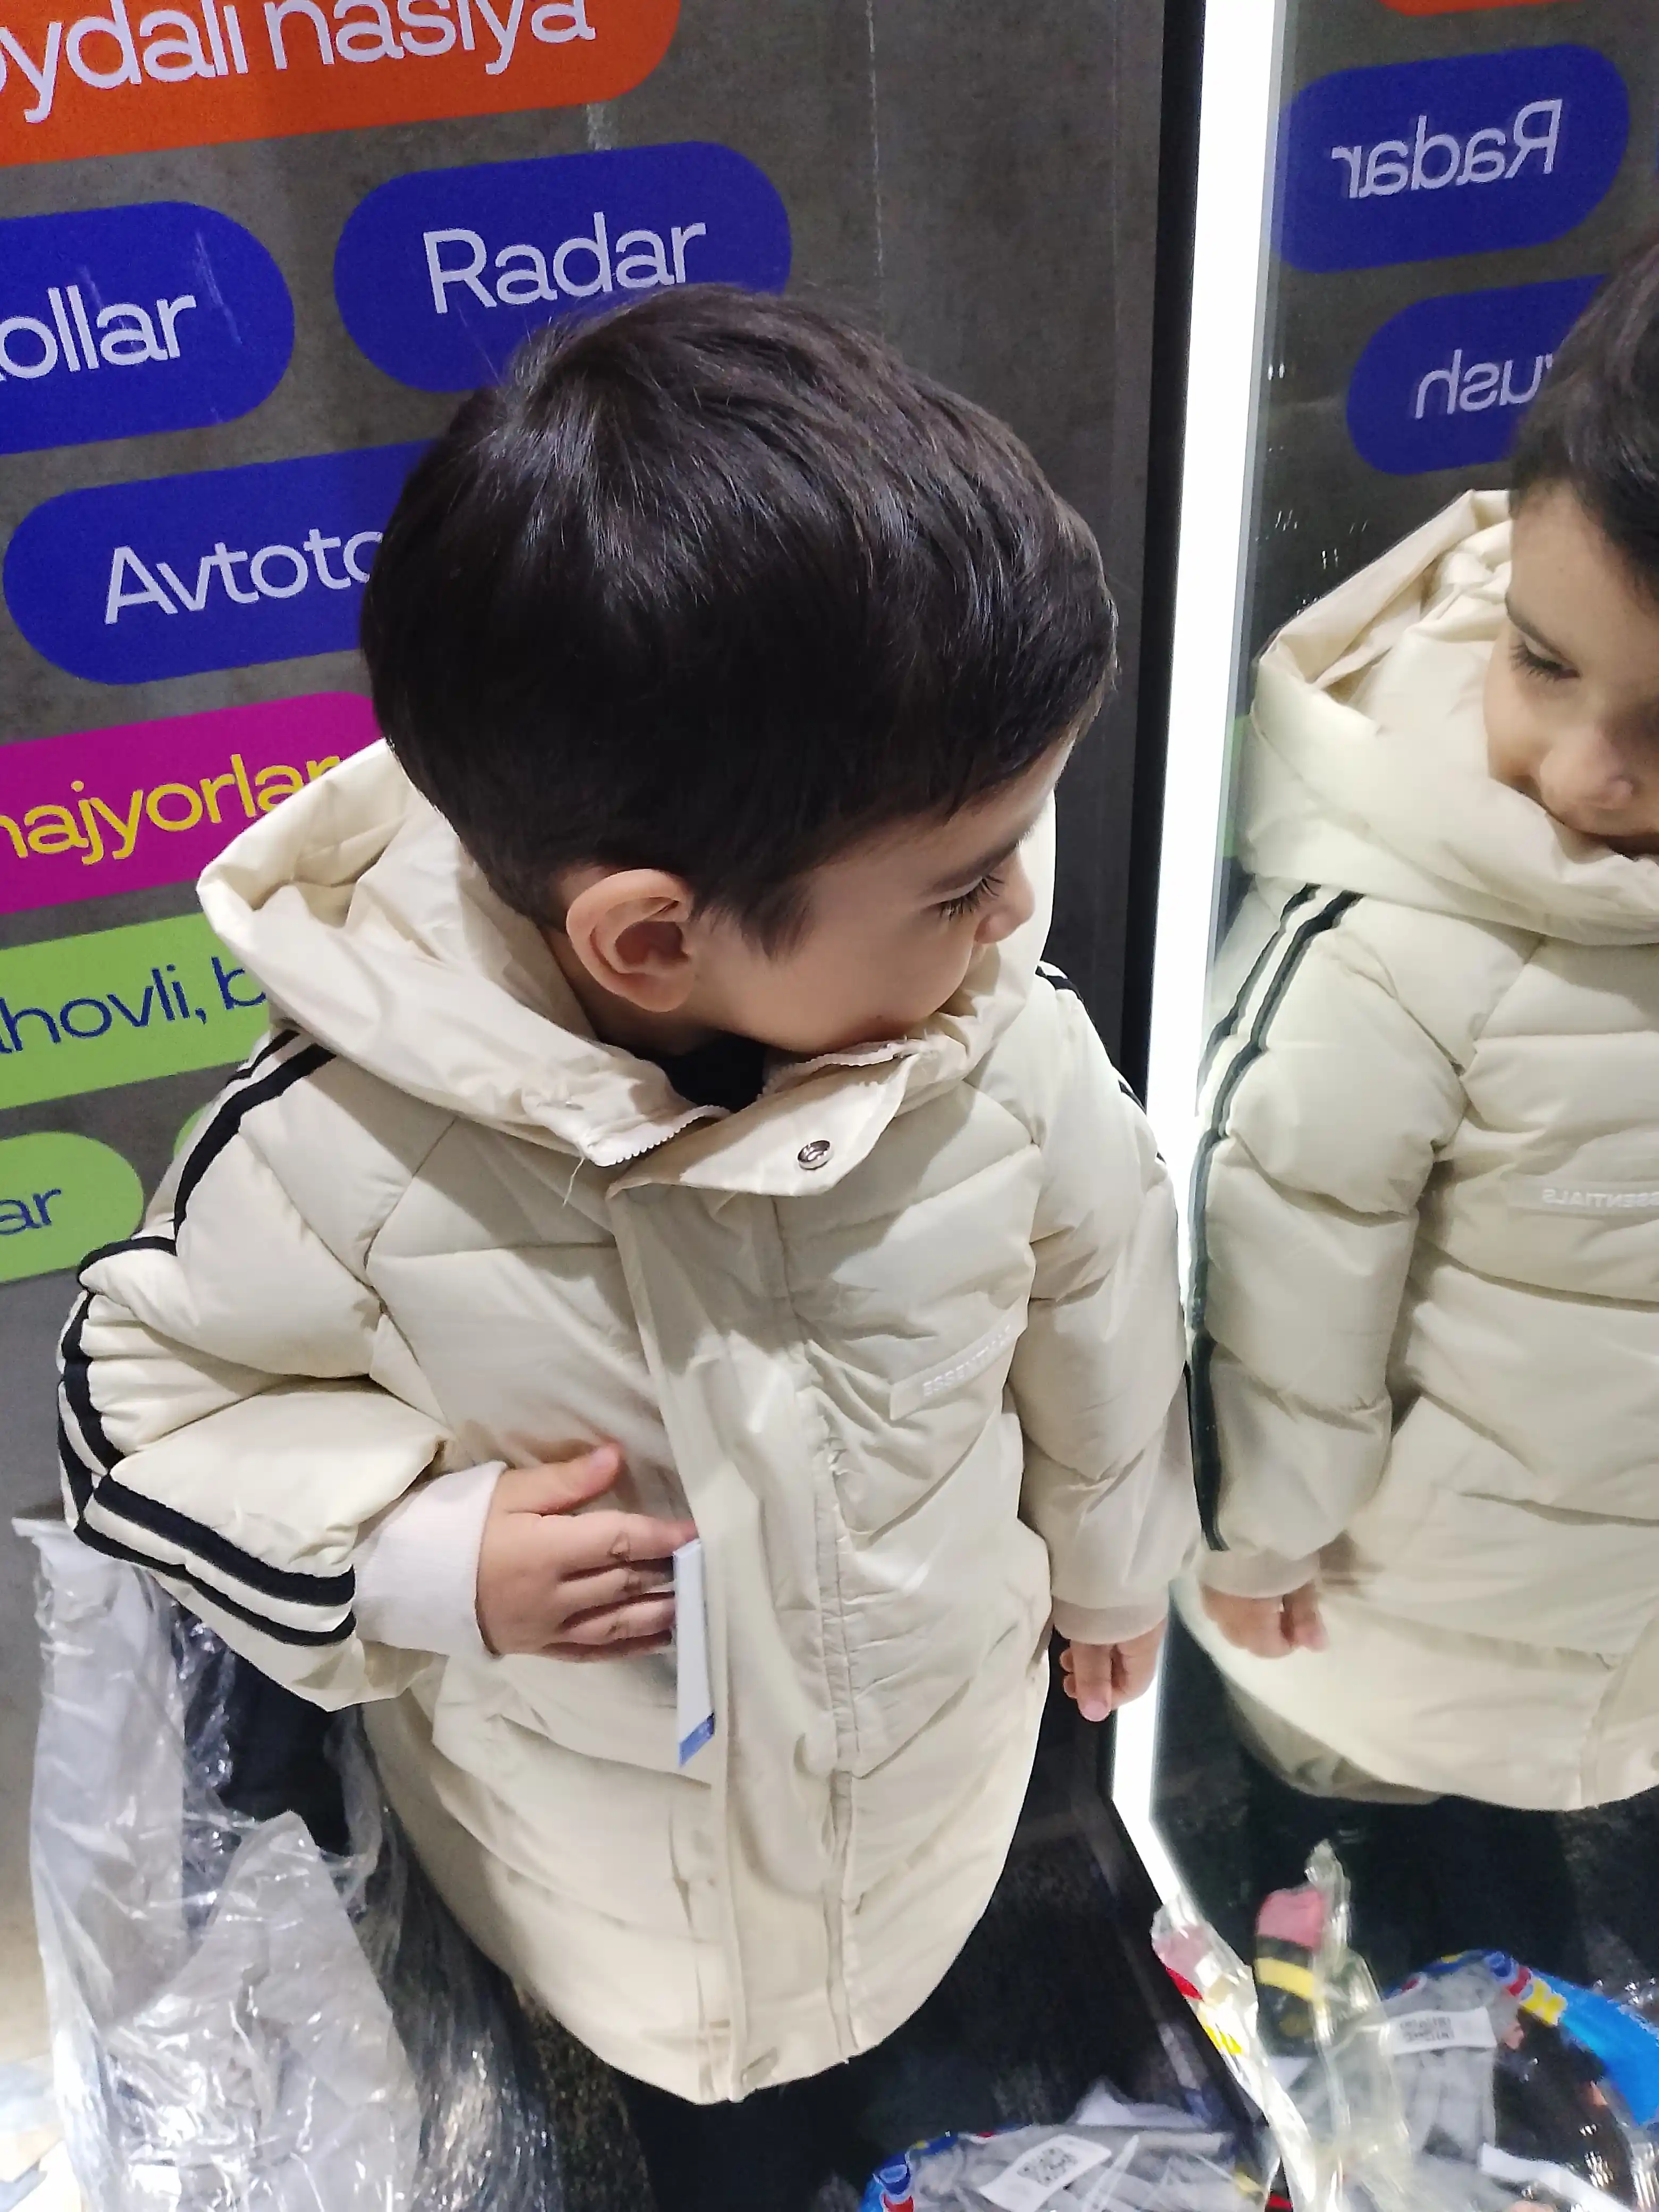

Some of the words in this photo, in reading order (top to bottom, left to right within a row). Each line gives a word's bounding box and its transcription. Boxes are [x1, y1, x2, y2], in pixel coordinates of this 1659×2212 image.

[0, 0, 248, 123] ydali
[423, 212, 707, 314] Radar
[0, 284, 197, 381] ollar
[0, 965, 207, 1054] hovli,
